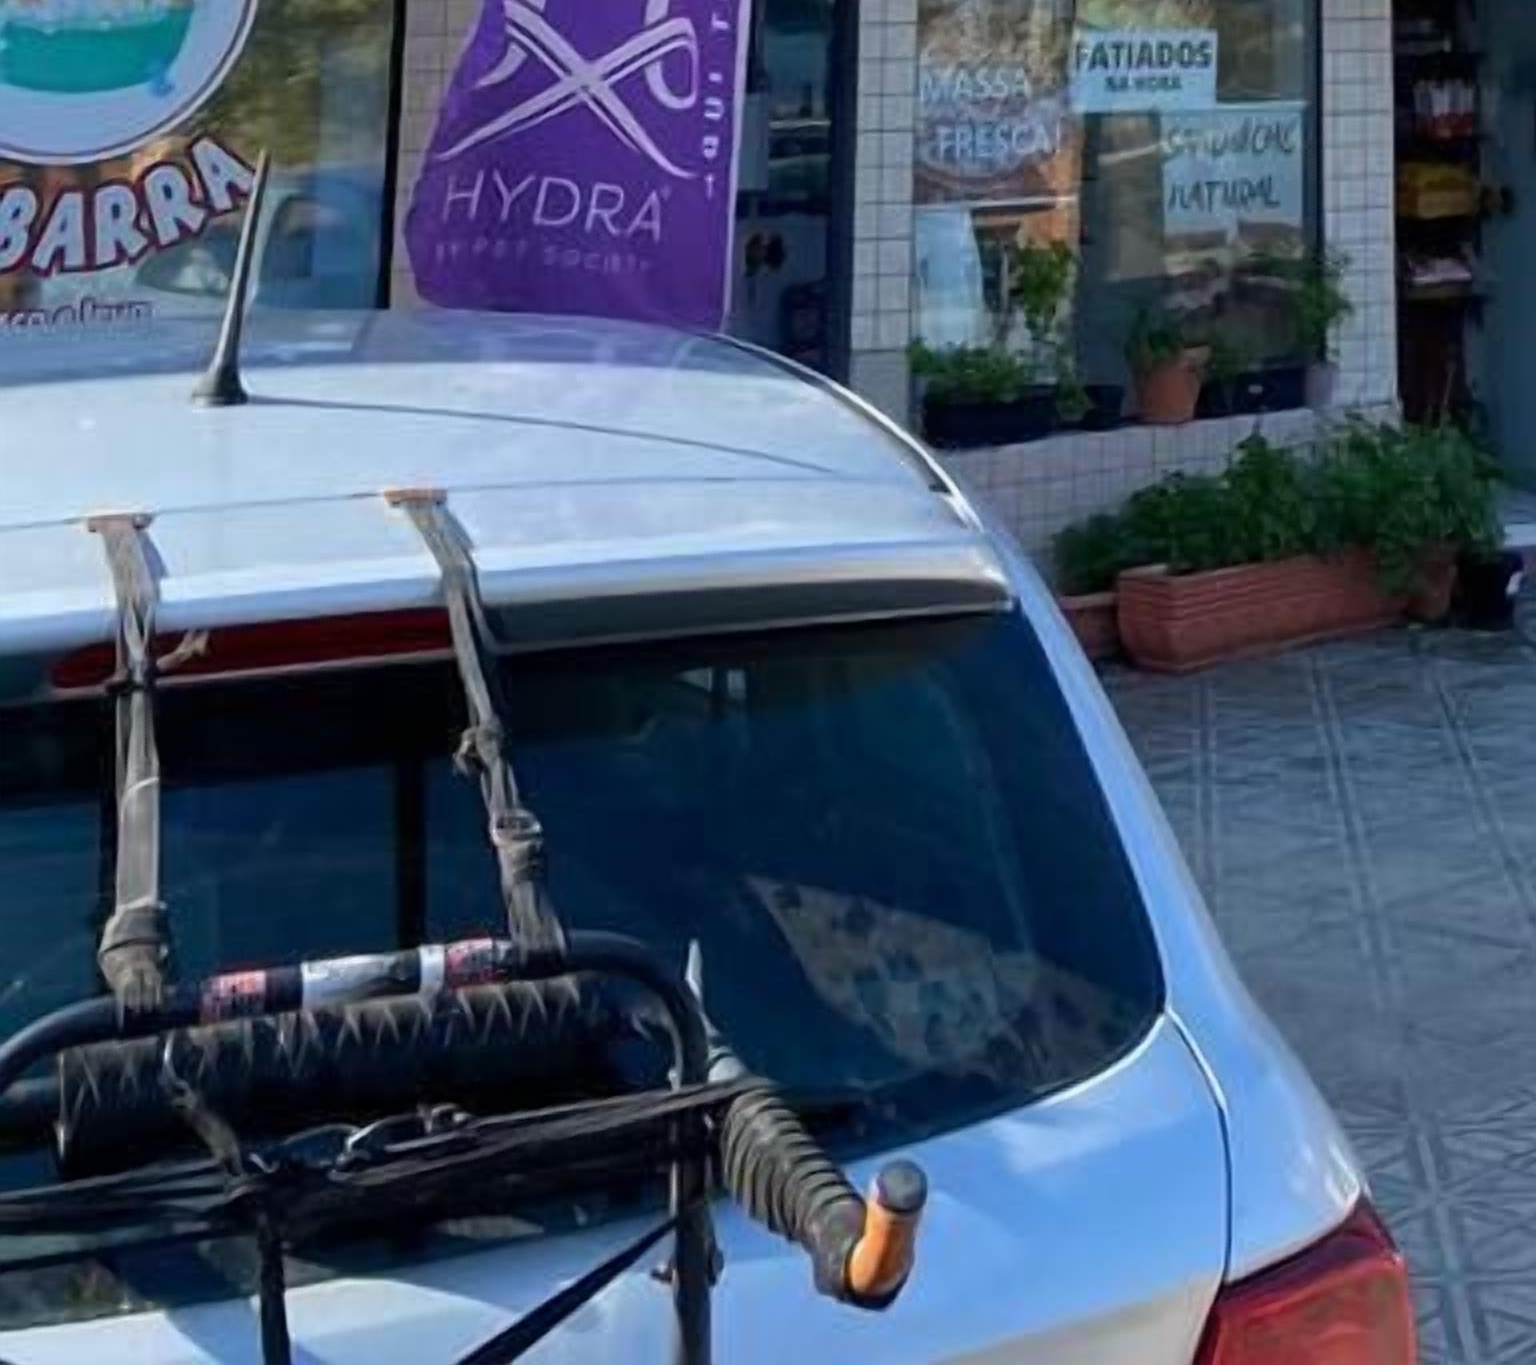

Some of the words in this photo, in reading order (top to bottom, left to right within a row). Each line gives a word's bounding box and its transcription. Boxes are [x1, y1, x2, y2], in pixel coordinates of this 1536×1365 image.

[1074, 40, 1213, 71] FATIADOS
[0, 136, 255, 277] BARRA
[441, 168, 663, 245] HYDRA
